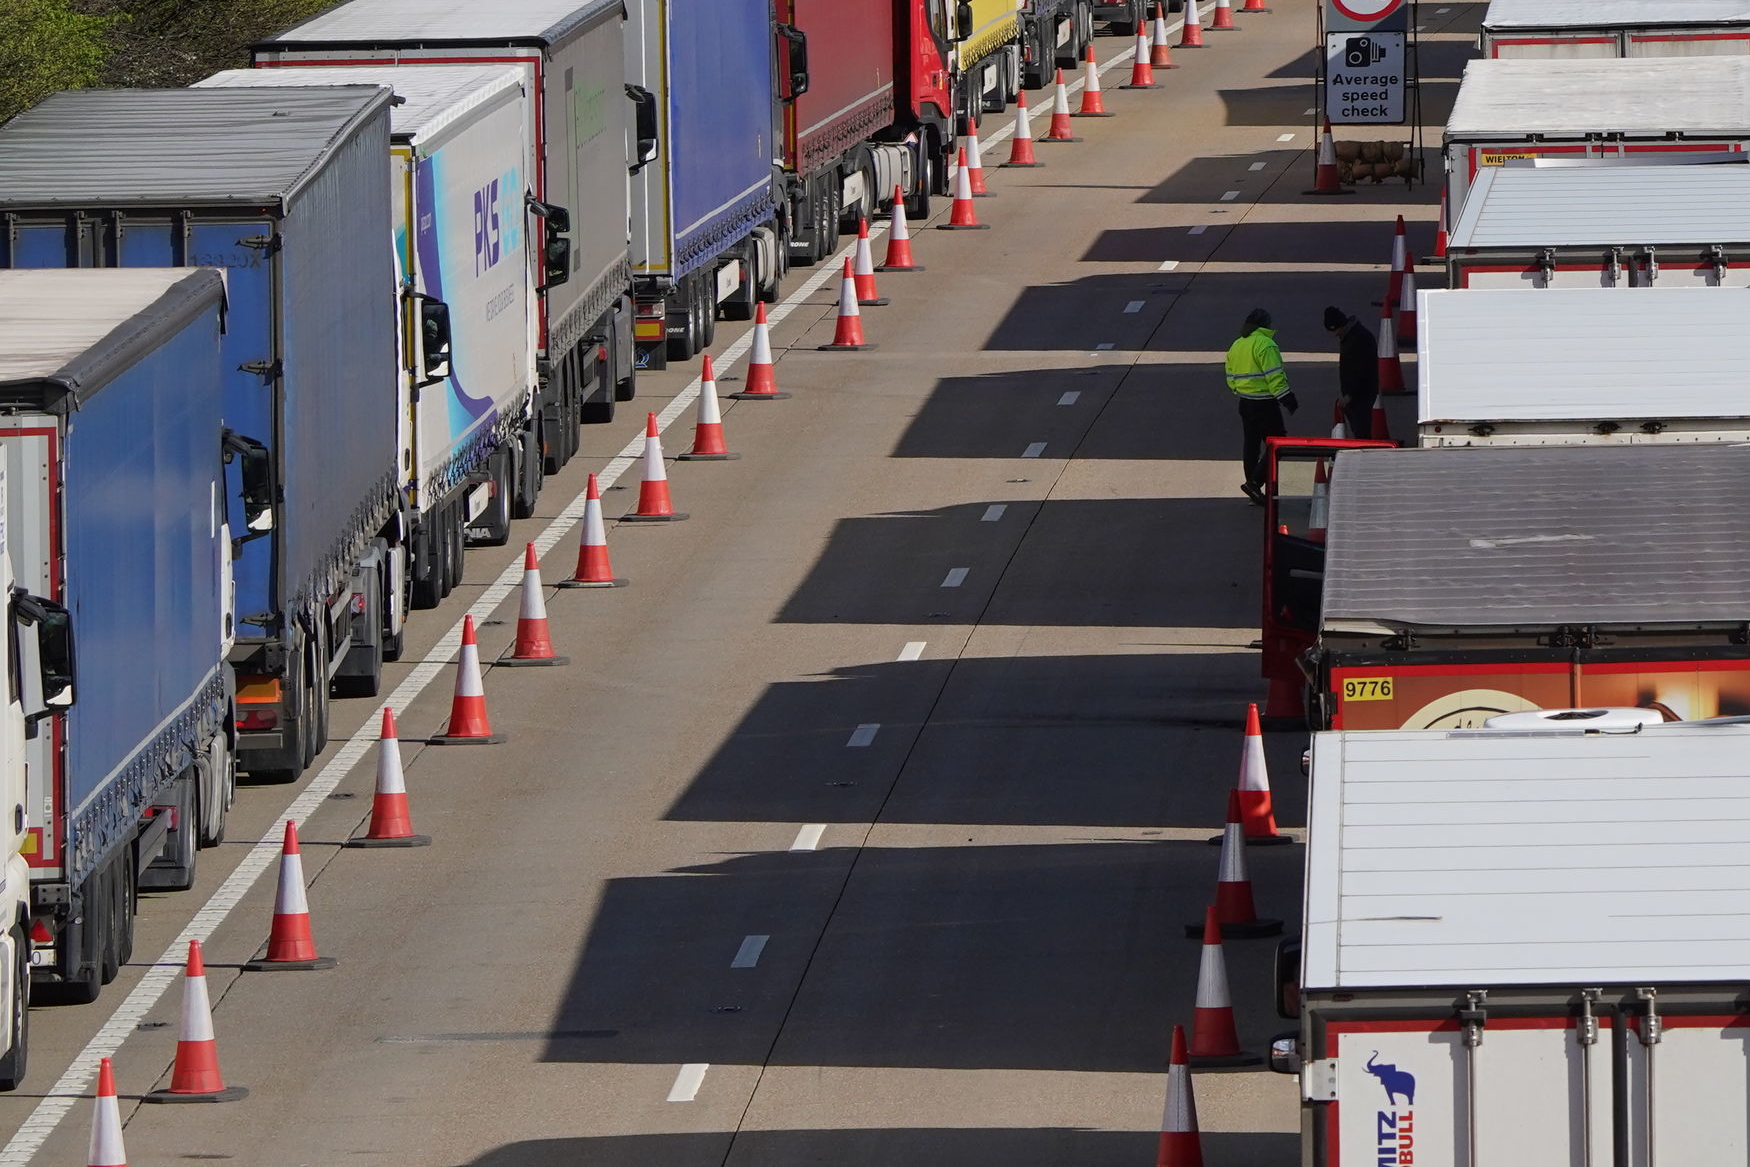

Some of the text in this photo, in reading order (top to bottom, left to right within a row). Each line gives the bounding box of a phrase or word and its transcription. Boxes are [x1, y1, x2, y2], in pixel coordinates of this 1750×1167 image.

[1332, 73, 1399, 87] Average
[1341, 88, 1389, 103] speed
[1341, 104, 1388, 118] check
[473, 177, 500, 278] PKS
[1345, 680, 1391, 698] 9776
